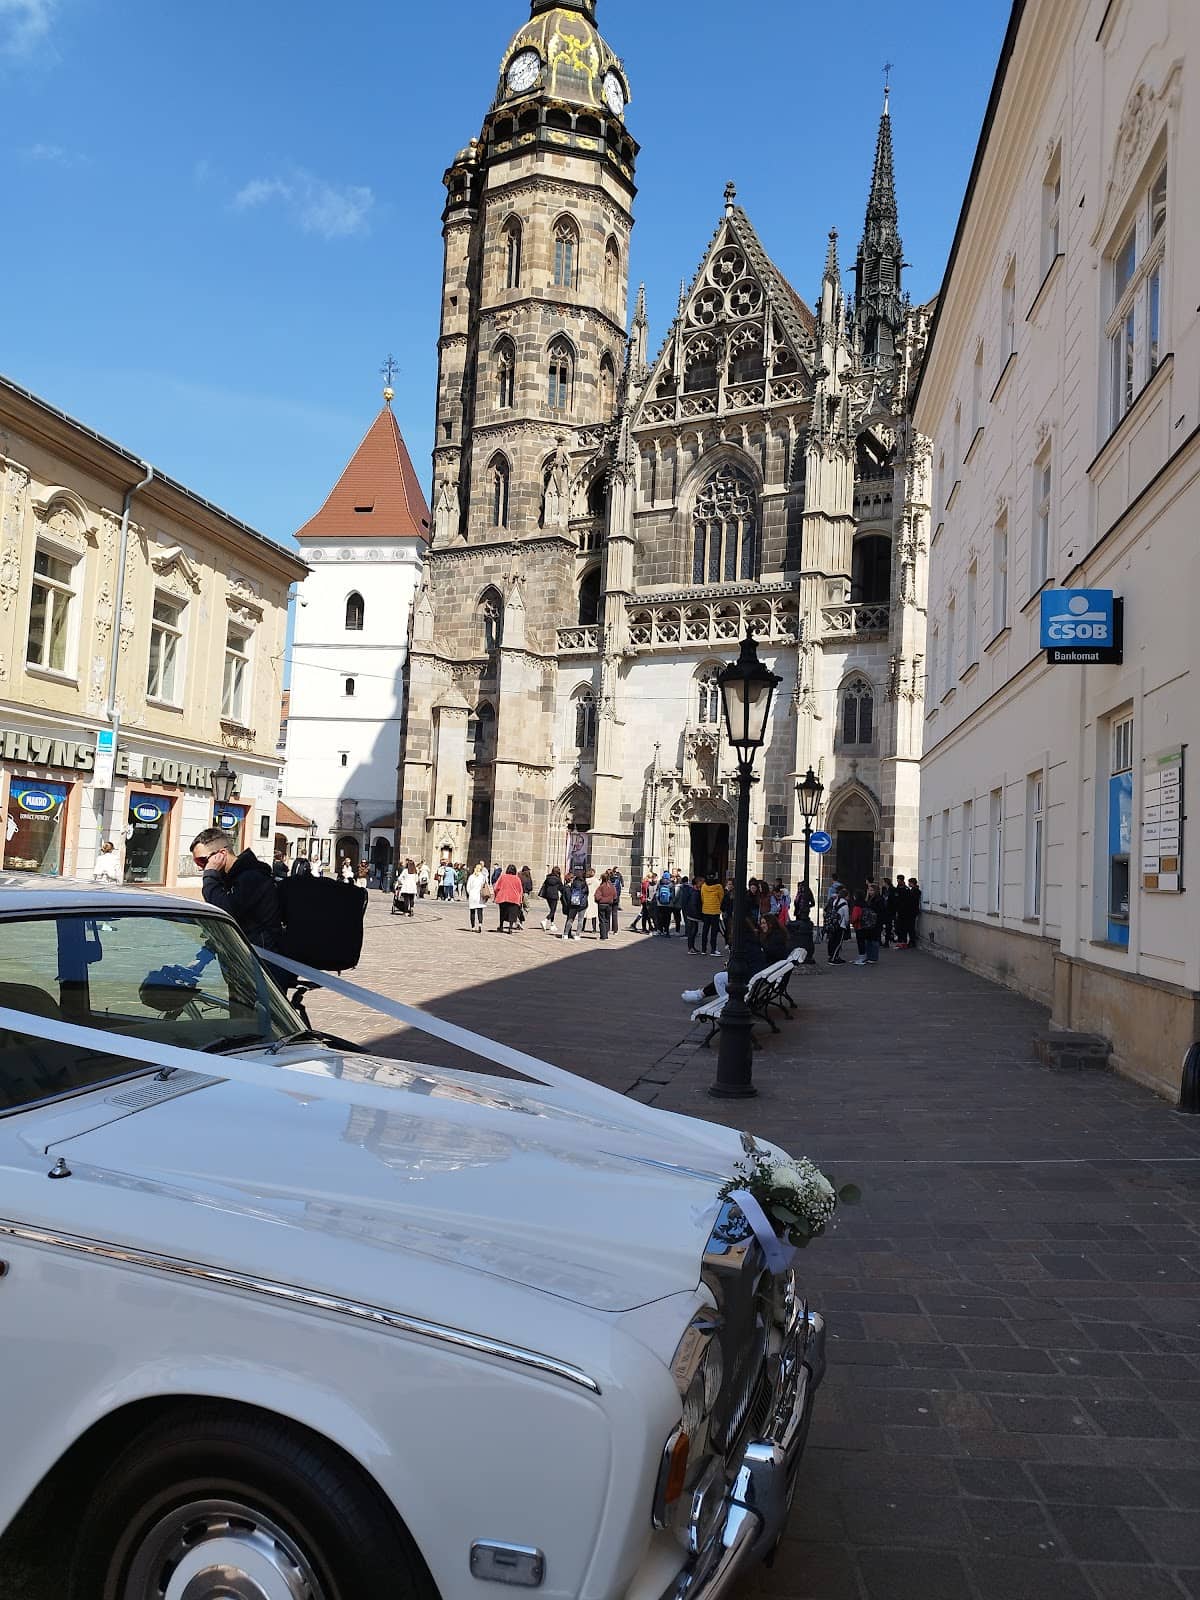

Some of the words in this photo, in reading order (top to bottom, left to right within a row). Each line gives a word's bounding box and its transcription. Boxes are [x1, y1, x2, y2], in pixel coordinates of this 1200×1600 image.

[1048, 623, 1108, 639] ČSOB
[1054, 651, 1099, 661] Bankomat
[0, 731, 129, 776] HYNSÉ
